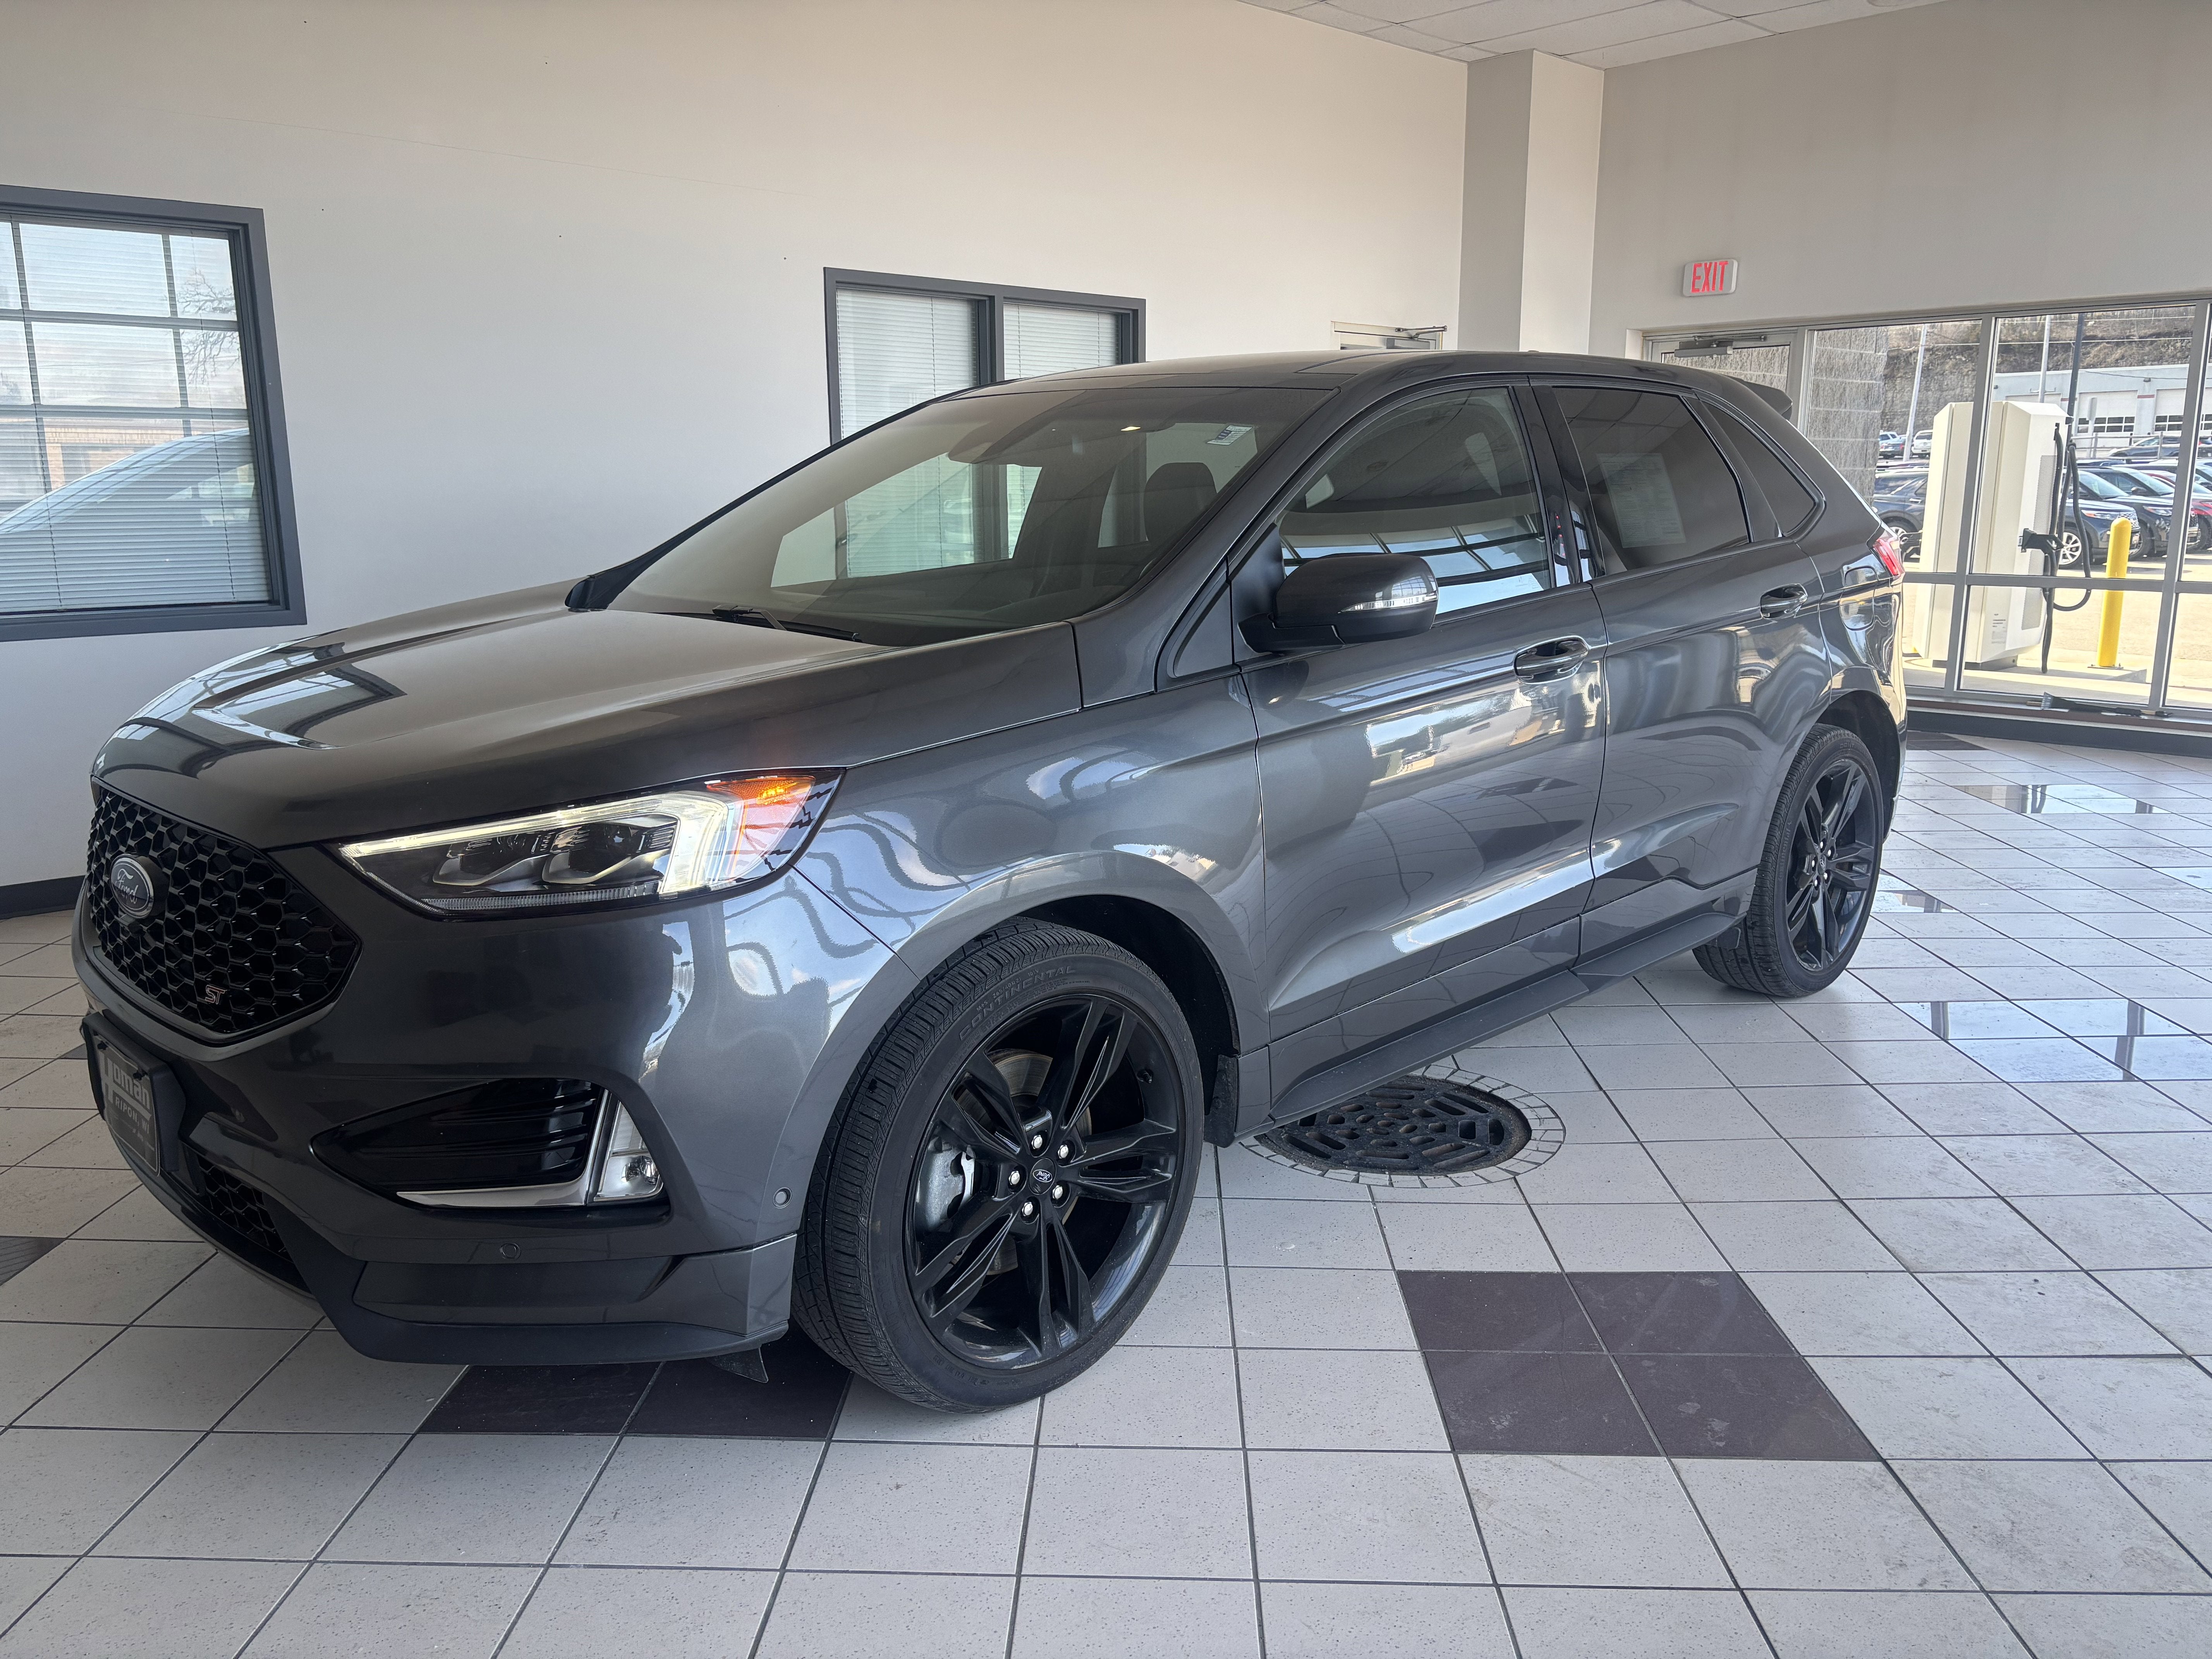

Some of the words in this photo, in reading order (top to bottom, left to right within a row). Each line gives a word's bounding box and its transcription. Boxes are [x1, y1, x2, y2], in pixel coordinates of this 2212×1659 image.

[1691, 261, 1729, 293] EXIT
[117, 869, 137, 904] Ford
[205, 985, 227, 1005] ST
[959, 966, 1076, 1041] CONTINENTAL
[98, 1051, 151, 1115] Homan
[1036, 1171, 1050, 1181] Ford
